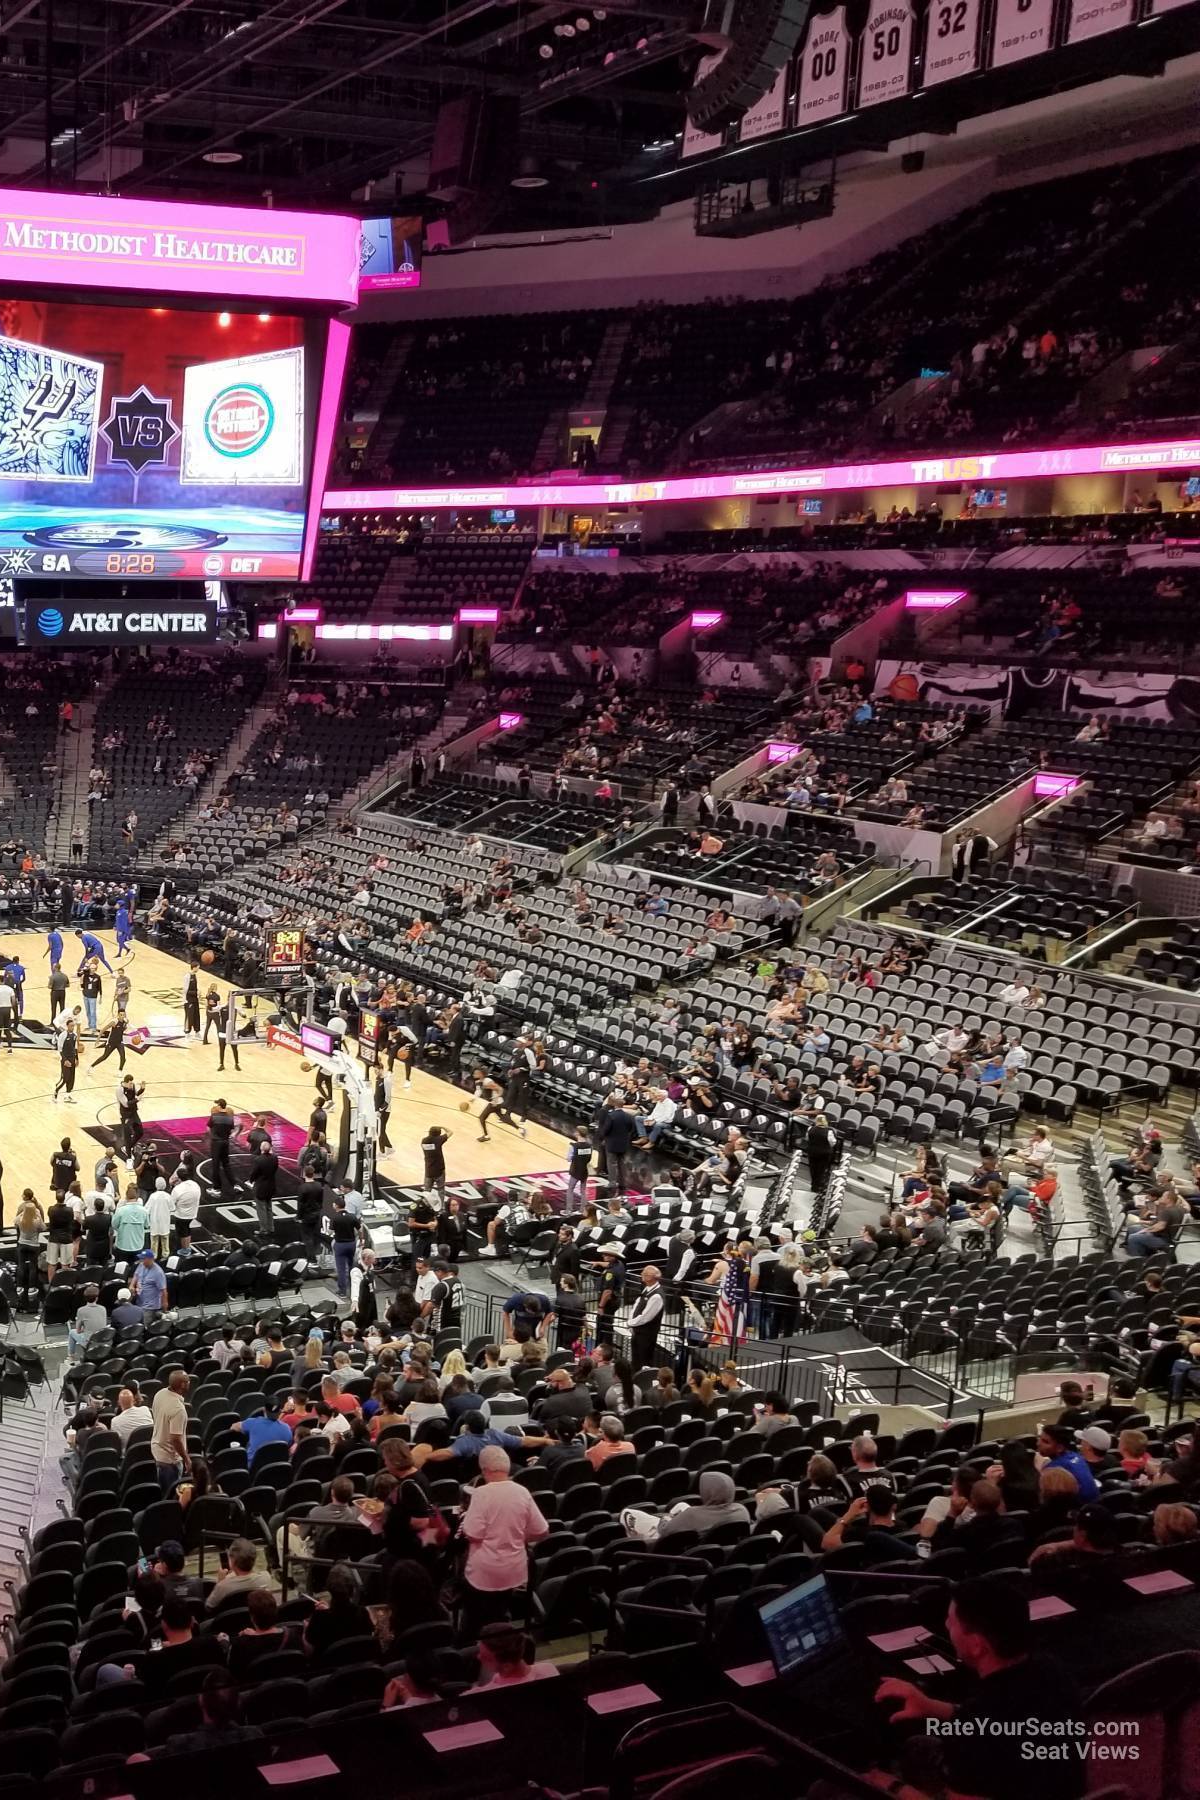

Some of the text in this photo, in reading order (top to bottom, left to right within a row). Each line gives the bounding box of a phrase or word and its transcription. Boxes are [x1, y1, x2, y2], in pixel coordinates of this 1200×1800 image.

[869, 7, 908, 32] ROBINSON
[938, 2, 967, 38] 32
[812, 30, 841, 50] MOORE
[873, 26, 901, 61] 50
[811, 47, 837, 81] 00
[4, 222, 298, 267] METHODIST HEALTHCARE
[117, 415, 163, 447] VS
[911, 456, 997, 482] TRUST
[604, 482, 666, 502] TRUST
[42, 554, 263, 573] SA 8:28 DET
[69, 613, 207, 632] AT&T CENTER
[277, 932, 300, 943] 8:28
[273, 943, 297, 963] 24
[451, 1283, 464, 1308] 21
[83, 1778, 95, 1793] 8
